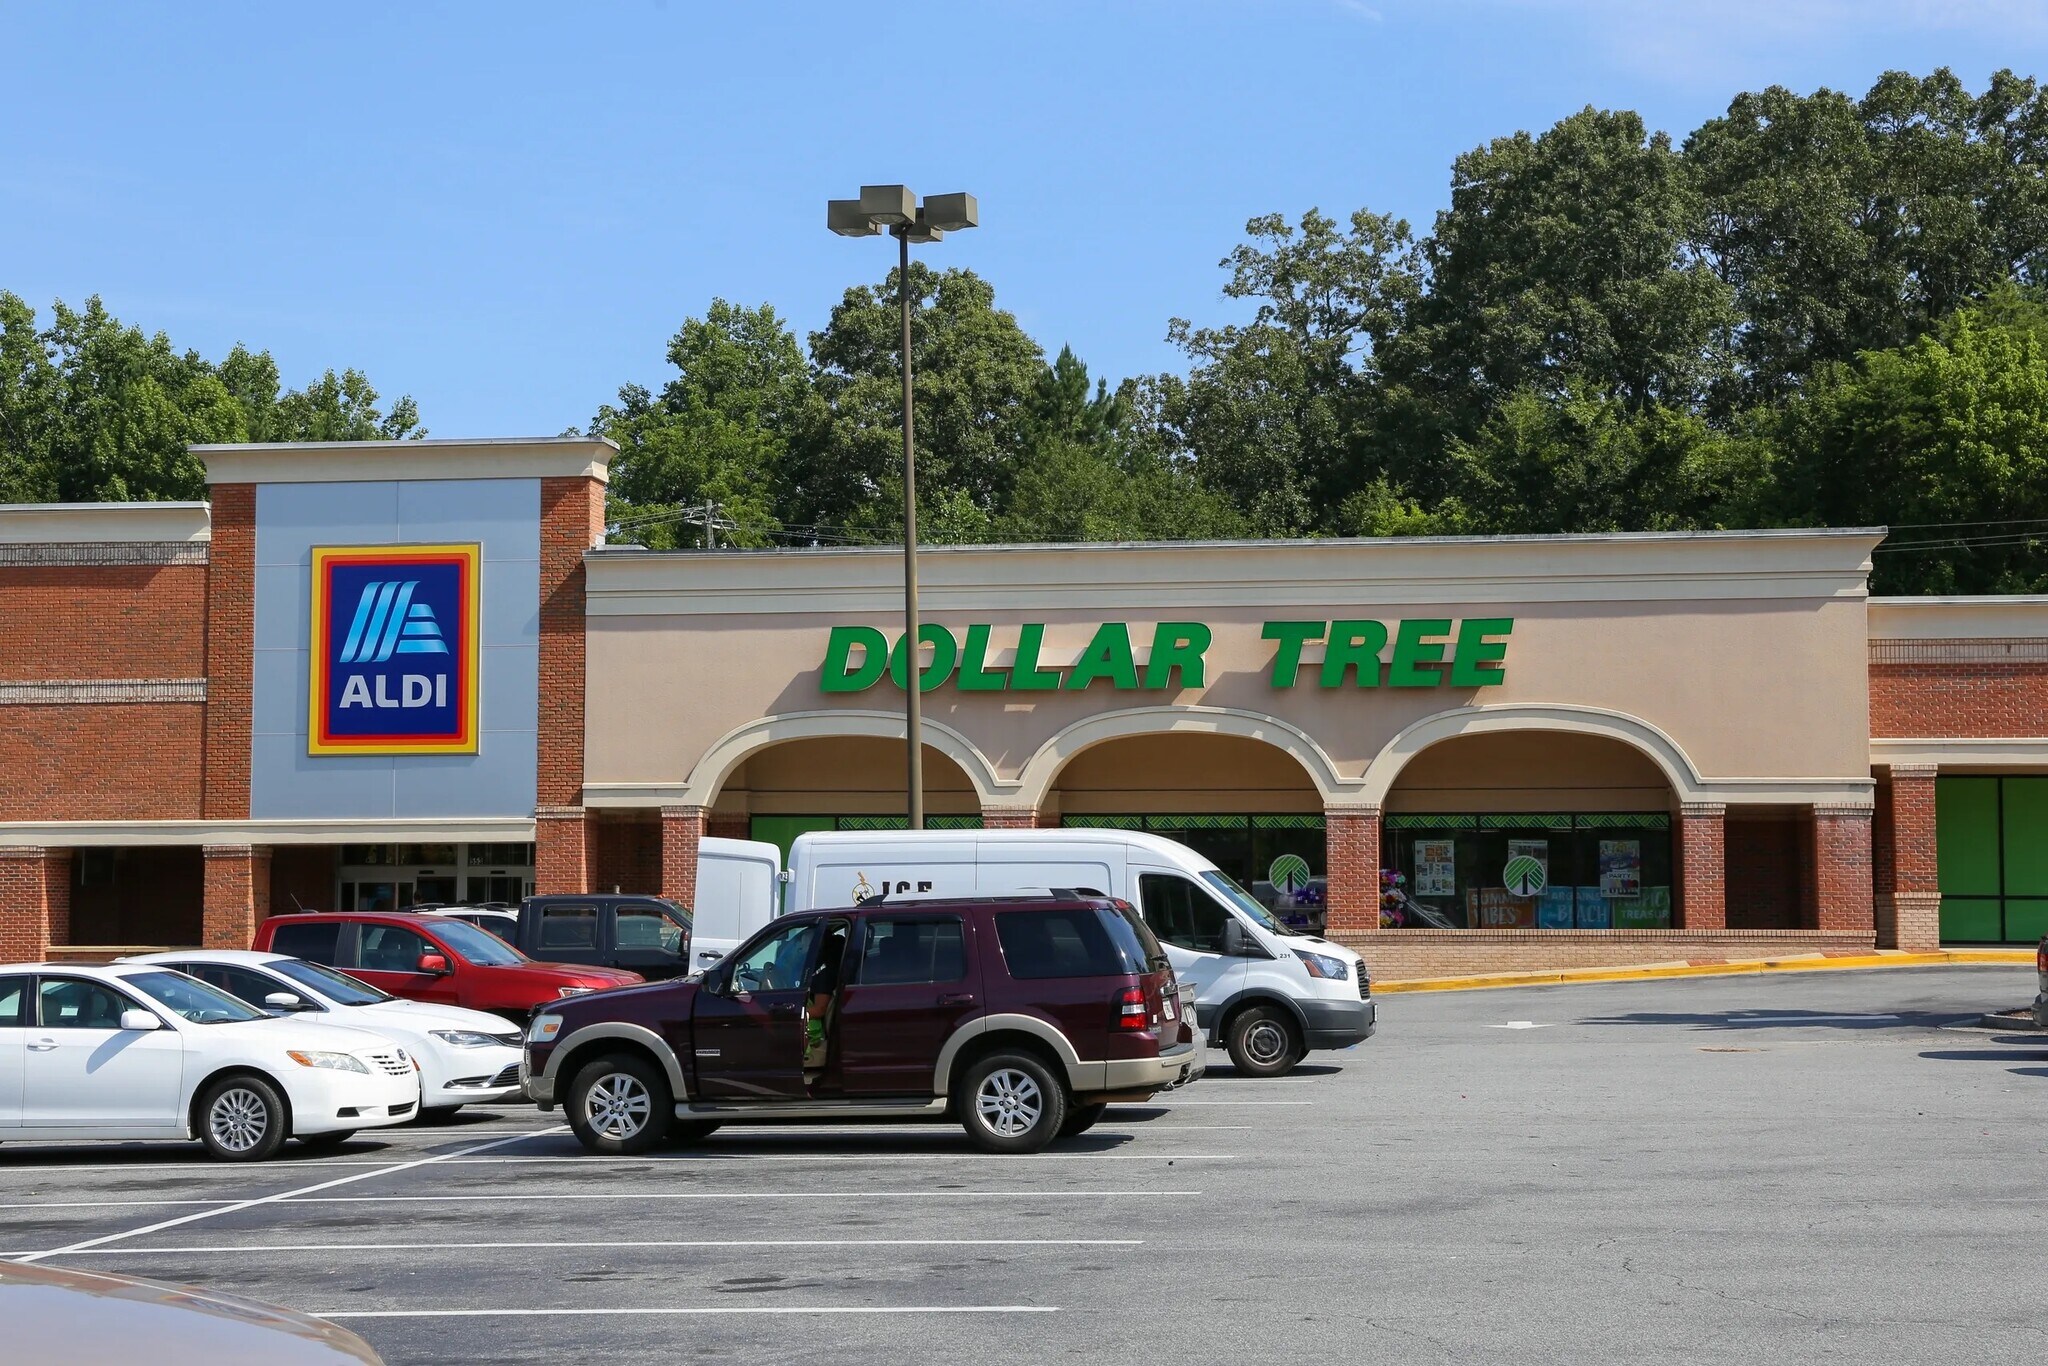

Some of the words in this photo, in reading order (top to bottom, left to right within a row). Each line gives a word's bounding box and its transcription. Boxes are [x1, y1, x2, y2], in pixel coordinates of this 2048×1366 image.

[820, 622, 1214, 692] DOLLAR
[1260, 618, 1514, 689] TREE
[338, 673, 447, 708] ALDI
